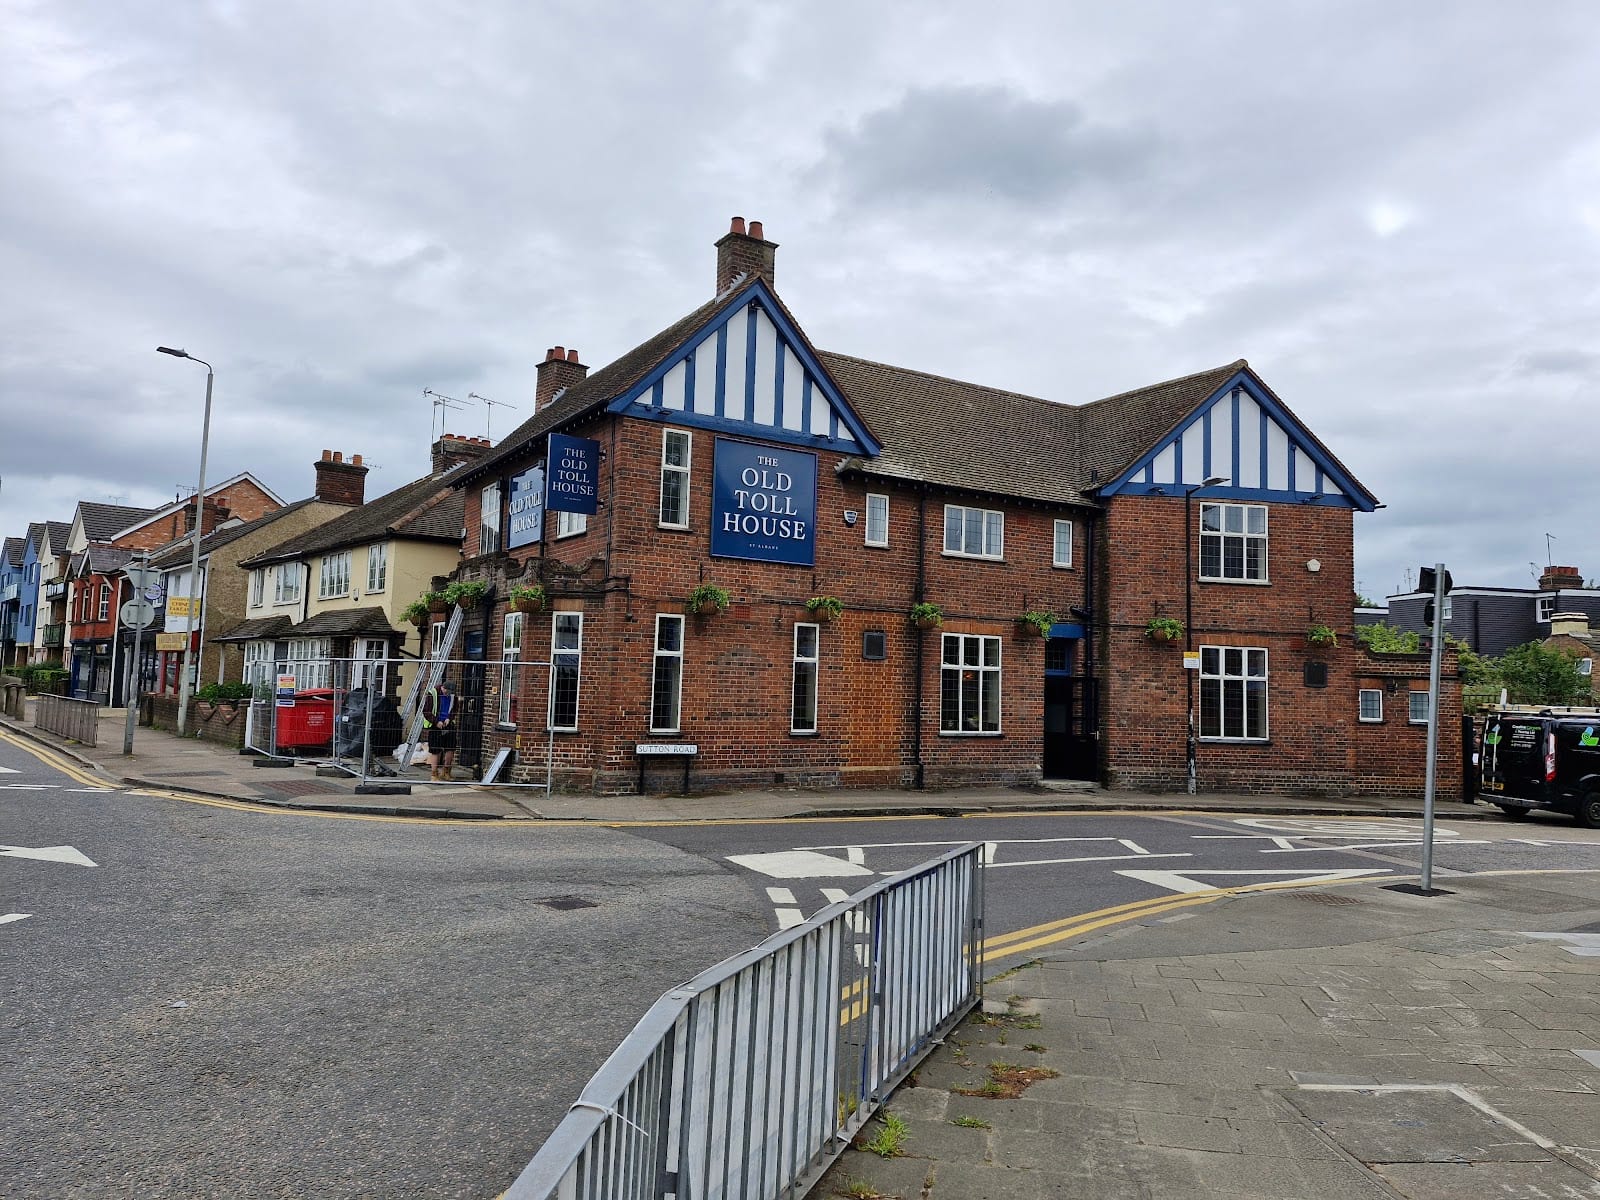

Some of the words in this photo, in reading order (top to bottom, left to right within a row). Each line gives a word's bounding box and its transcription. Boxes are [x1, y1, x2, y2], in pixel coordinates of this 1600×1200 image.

[564, 447, 586, 459] THE
[561, 458, 588, 471] OLD
[757, 455, 779, 467] THE
[558, 469, 590, 483] TOLL
[741, 467, 792, 492] OLD
[552, 481, 594, 496] HOUSE
[734, 489, 798, 516] TOLL
[512, 512, 538, 534] HOUSE
[722, 511, 806, 540] HOUSE
[638, 745, 671, 753] SUTTON
[673, 745, 697, 753] ROAD
